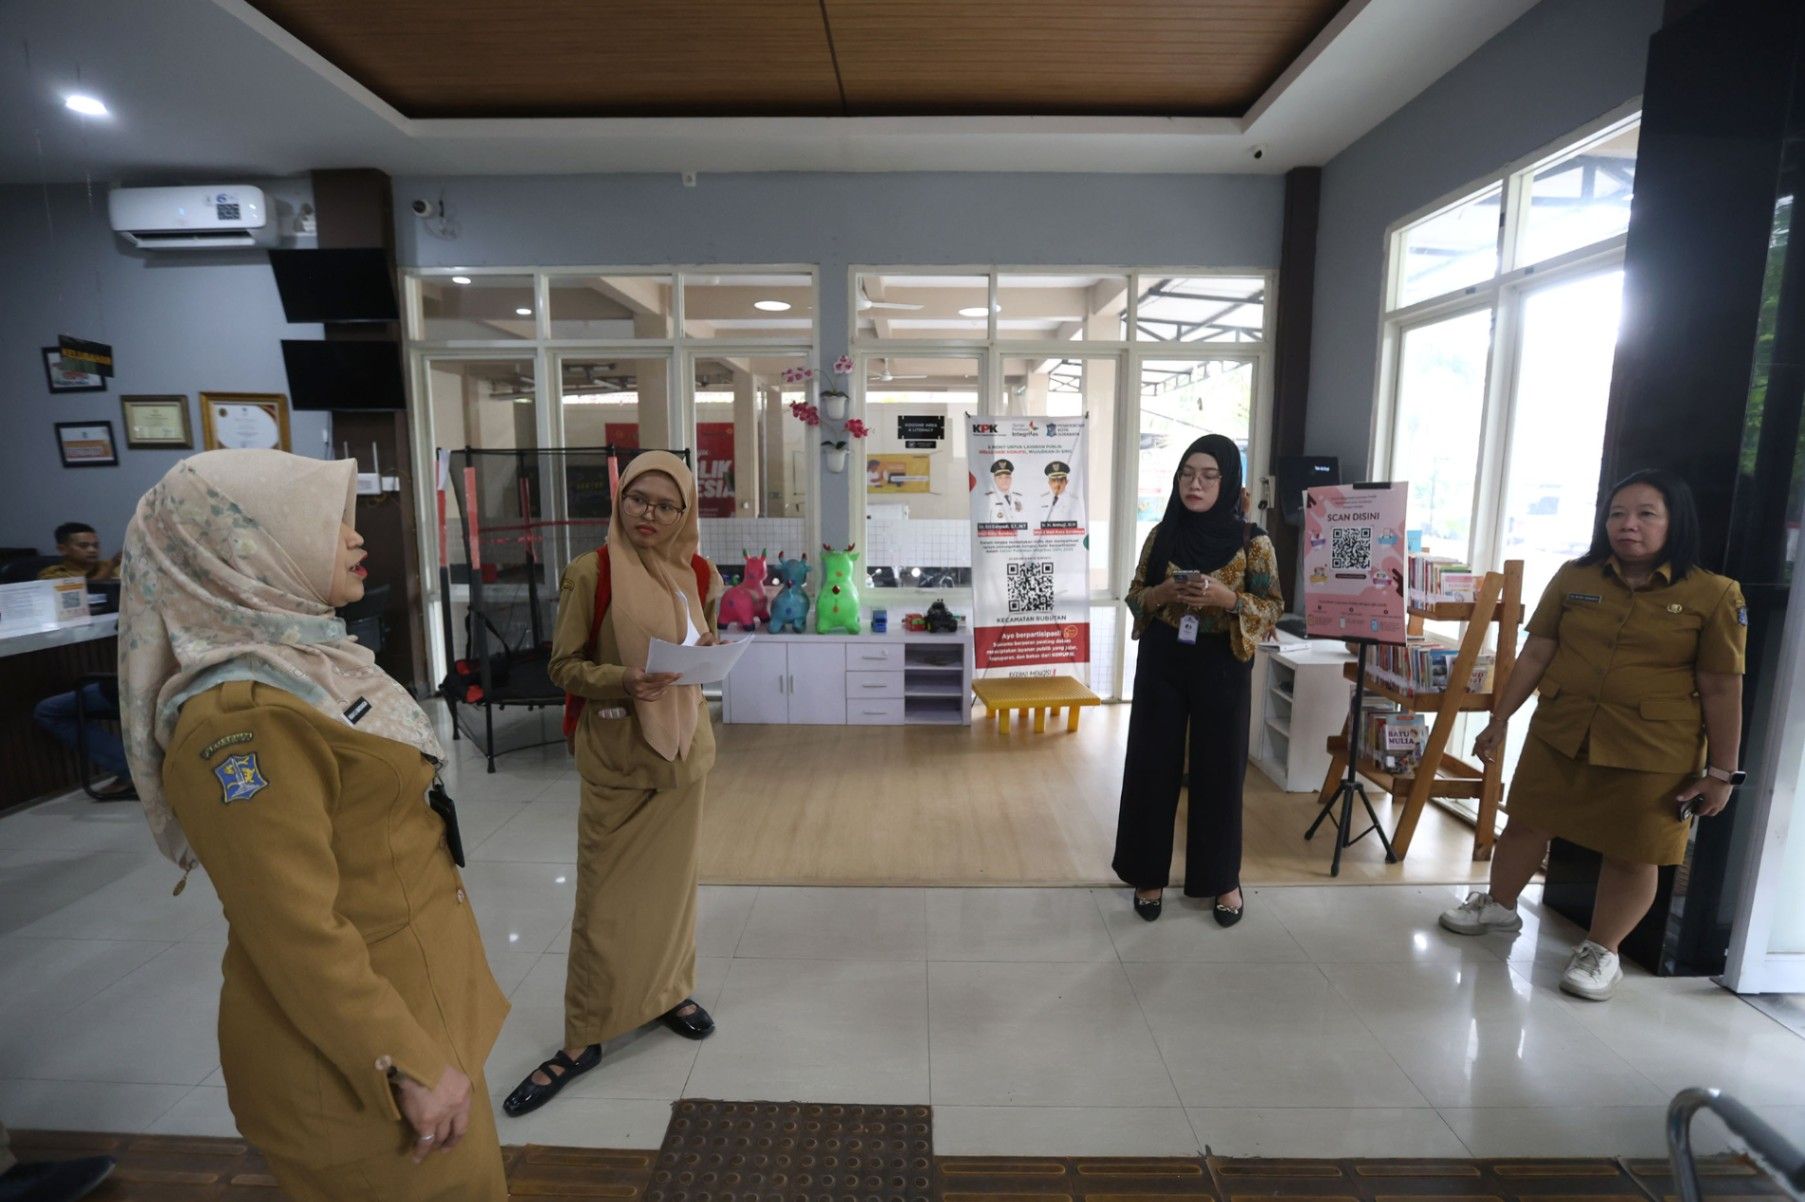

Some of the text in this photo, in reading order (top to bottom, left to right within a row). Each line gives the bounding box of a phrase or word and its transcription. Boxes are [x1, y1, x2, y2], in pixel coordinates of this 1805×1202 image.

[973, 424, 998, 434] KPK
[1327, 512, 1380, 522] SCAN DISINI
[1002, 632, 1015, 640] Ayo
